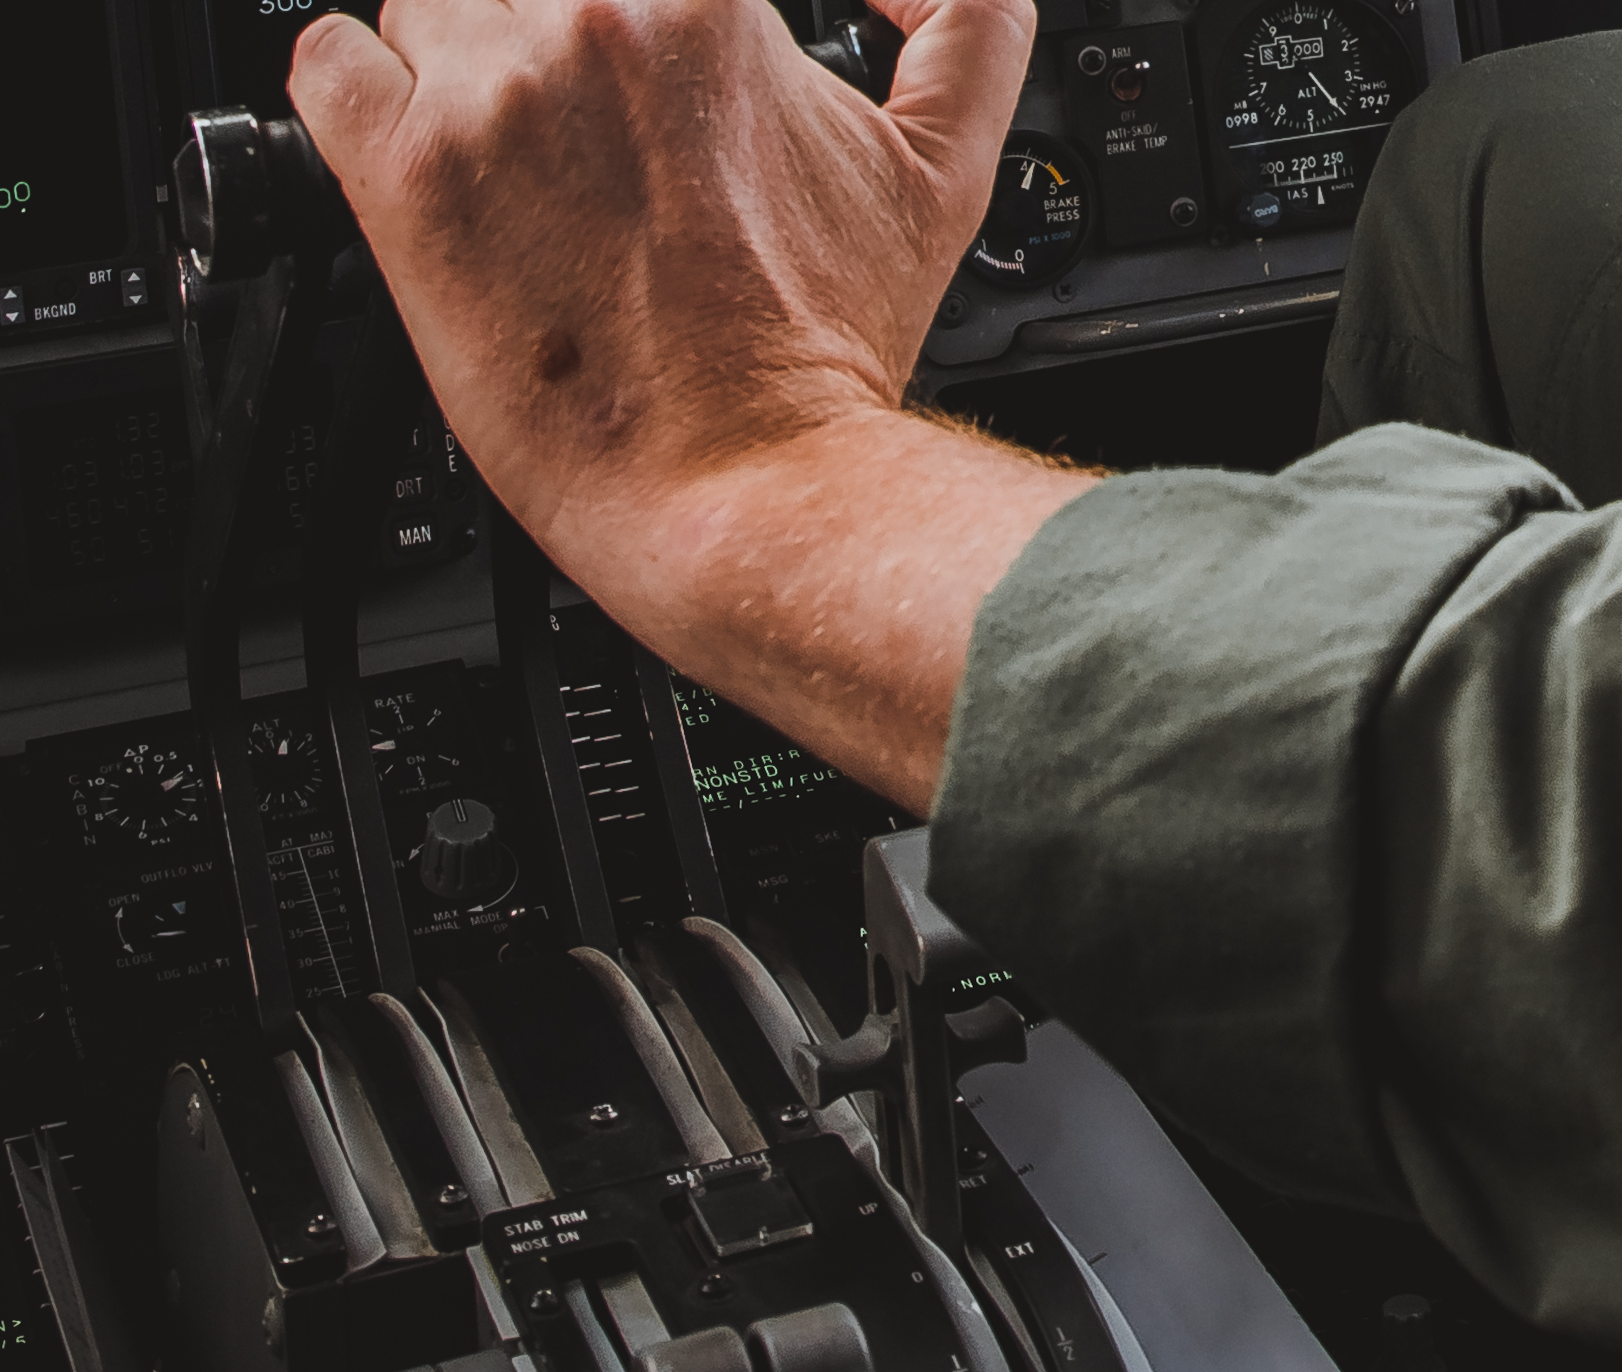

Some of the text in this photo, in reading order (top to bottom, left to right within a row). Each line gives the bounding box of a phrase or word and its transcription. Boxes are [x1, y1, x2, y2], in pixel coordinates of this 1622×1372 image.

[1297, 87, 1317, 99] ALT
[1359, 95, 1390, 109] 2947
[1226, 113, 1258, 128] 0998
[1043, 195, 1080, 211] BRAKE
[1287, 191, 1308, 200] IAS
[399, 523, 432, 548] MAN
[695, 764, 779, 792] NONSTD
[141, 861, 213, 884] OUTFLO VLV
[470, 910, 504, 926] MODE
[504, 1210, 588, 1237] STAB TRIM
[511, 1231, 580, 1254] NOSE DN
